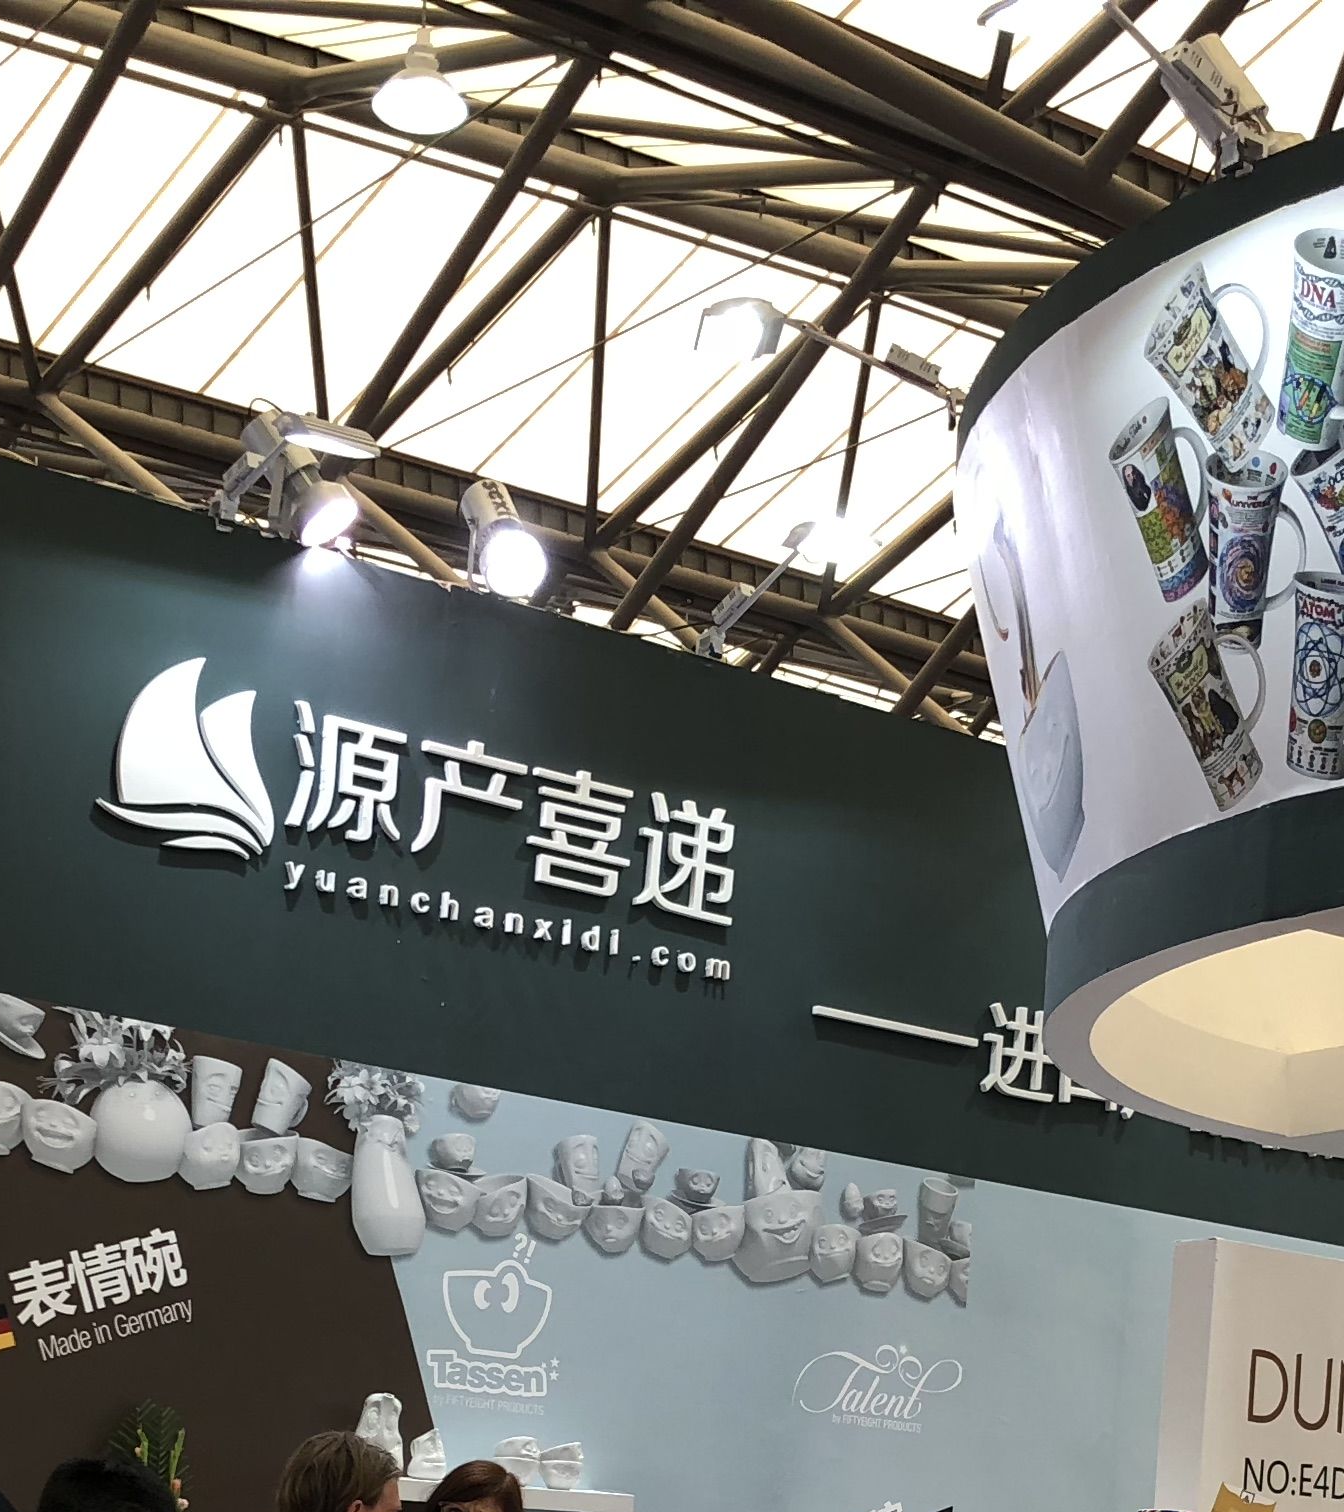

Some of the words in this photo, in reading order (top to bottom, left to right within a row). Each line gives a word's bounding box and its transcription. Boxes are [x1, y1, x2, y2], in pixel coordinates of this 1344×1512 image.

[1300, 277, 1336, 308] DNA
[1301, 599, 1336, 620] ATOM
[284, 700, 735, 926] 源产喜递
[283, 860, 731, 982] yuanchanxidi.com
[8, 1229, 188, 1329] 表情碗
[38, 1321, 93, 1362] Made
[96, 1314, 113, 1344] in
[115, 1299, 194, 1342] Germany
[427, 1350, 547, 1397] Tassen
[792, 1344, 963, 1419] Talent
[883, 1418, 922, 1434] PRODUCTS
